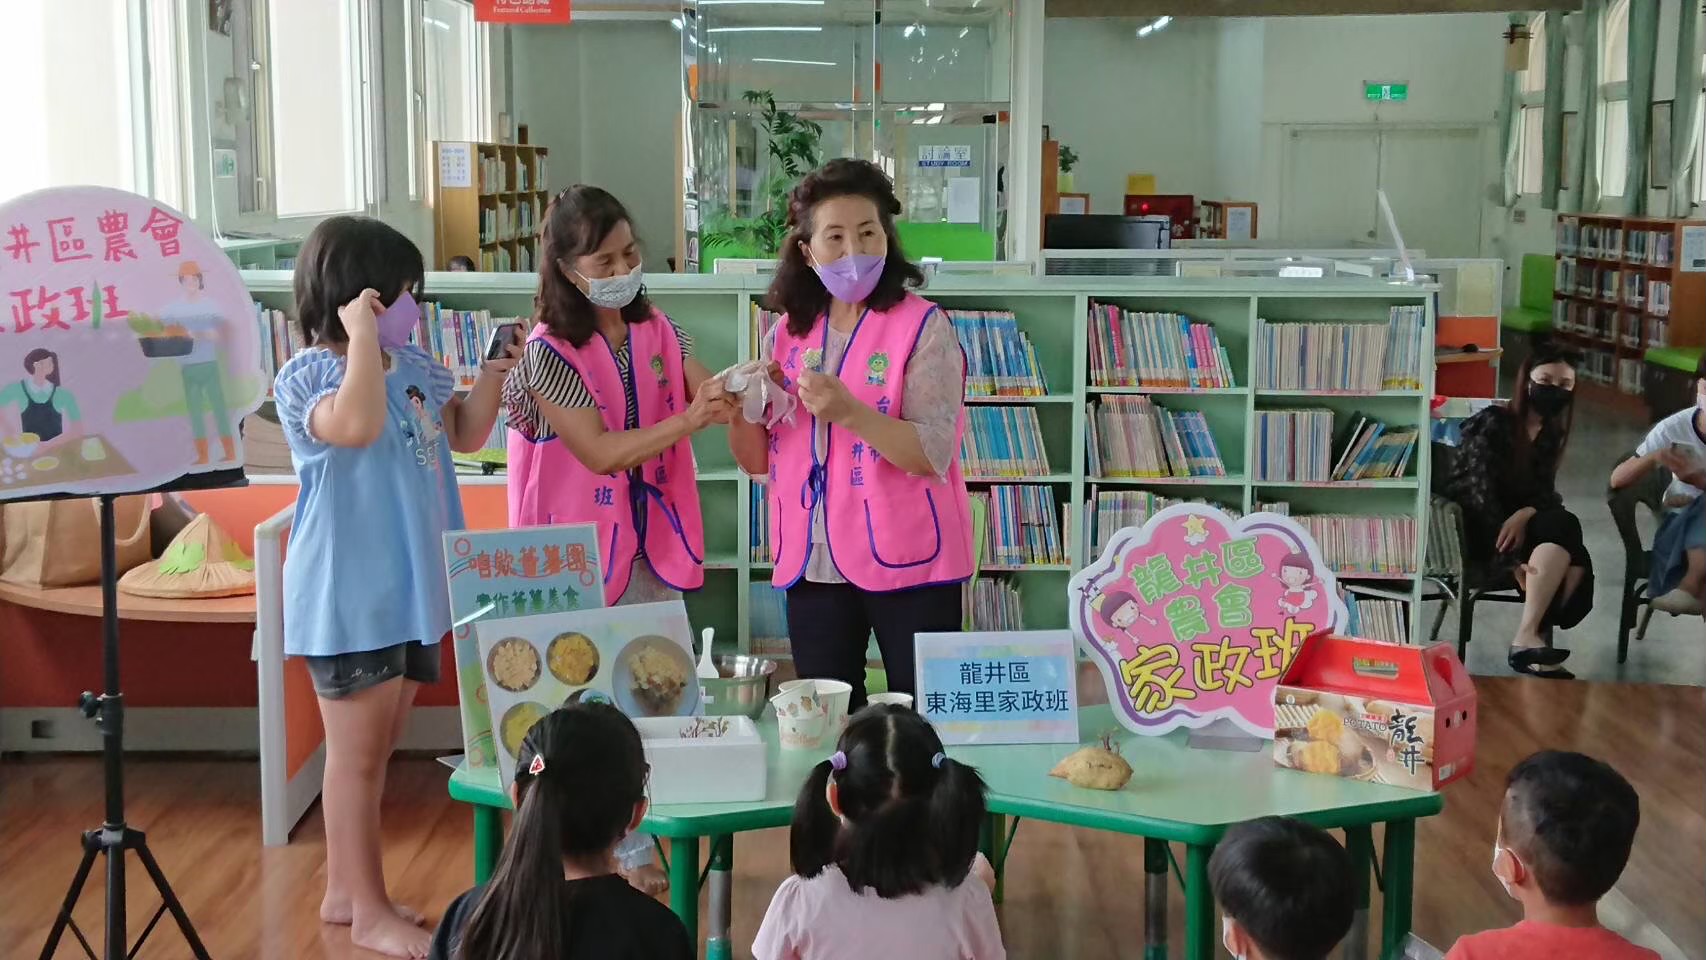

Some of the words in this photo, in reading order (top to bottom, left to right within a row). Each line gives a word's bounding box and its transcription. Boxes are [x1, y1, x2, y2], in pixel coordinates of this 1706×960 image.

[0, 284, 129, 333] 政班
[1128, 536, 1265, 604] 龍井區
[1164, 583, 1253, 642] 農會
[959, 661, 1031, 685] 龍井區
[1119, 616, 1315, 713] 家政班
[925, 689, 1069, 714] 東海里家政班
[1343, 717, 1388, 733] POTATO
